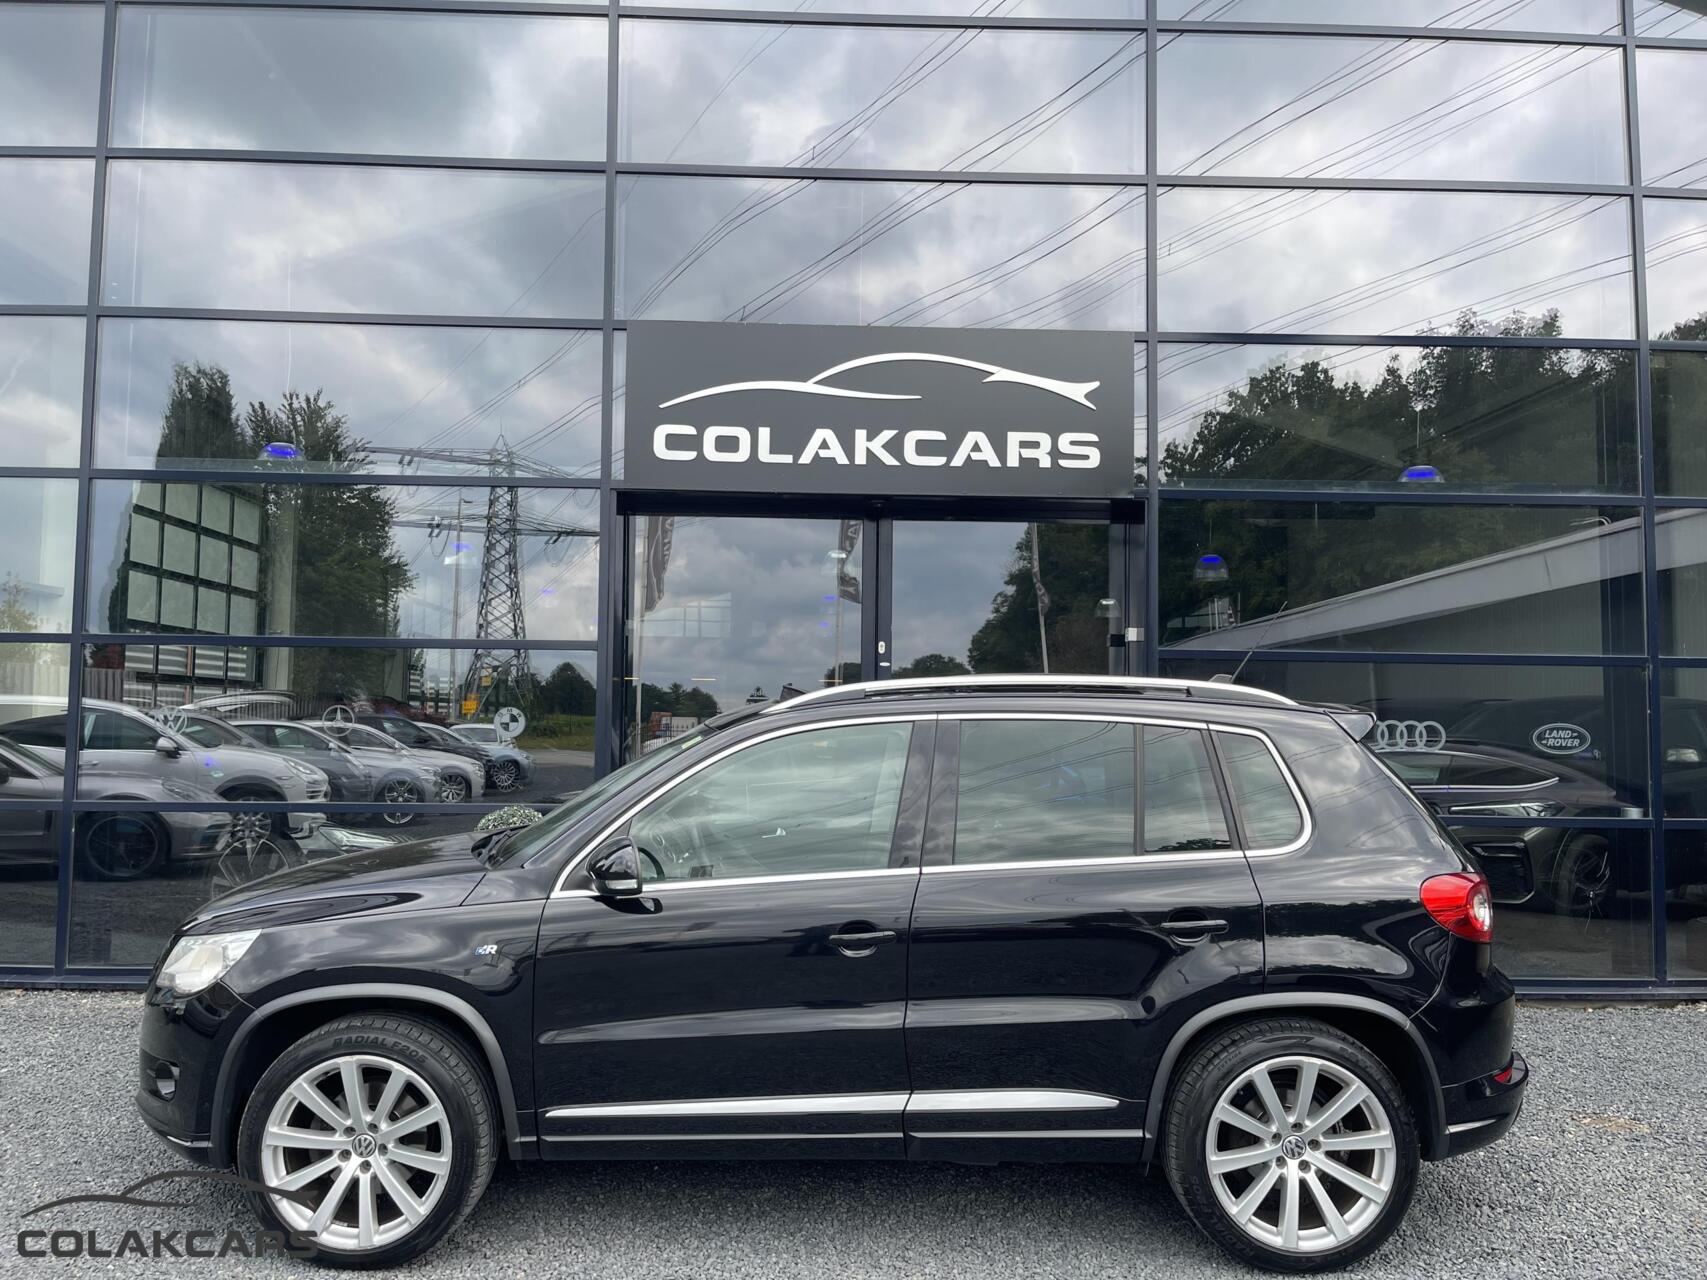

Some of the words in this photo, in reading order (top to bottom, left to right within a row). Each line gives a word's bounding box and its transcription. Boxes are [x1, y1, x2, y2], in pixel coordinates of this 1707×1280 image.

[653, 424, 1101, 469] COLAKCARS
[1545, 730, 1572, 738] LAND
[1547, 738, 1580, 747] ROVER
[331, 1036, 389, 1049] RADIAL
